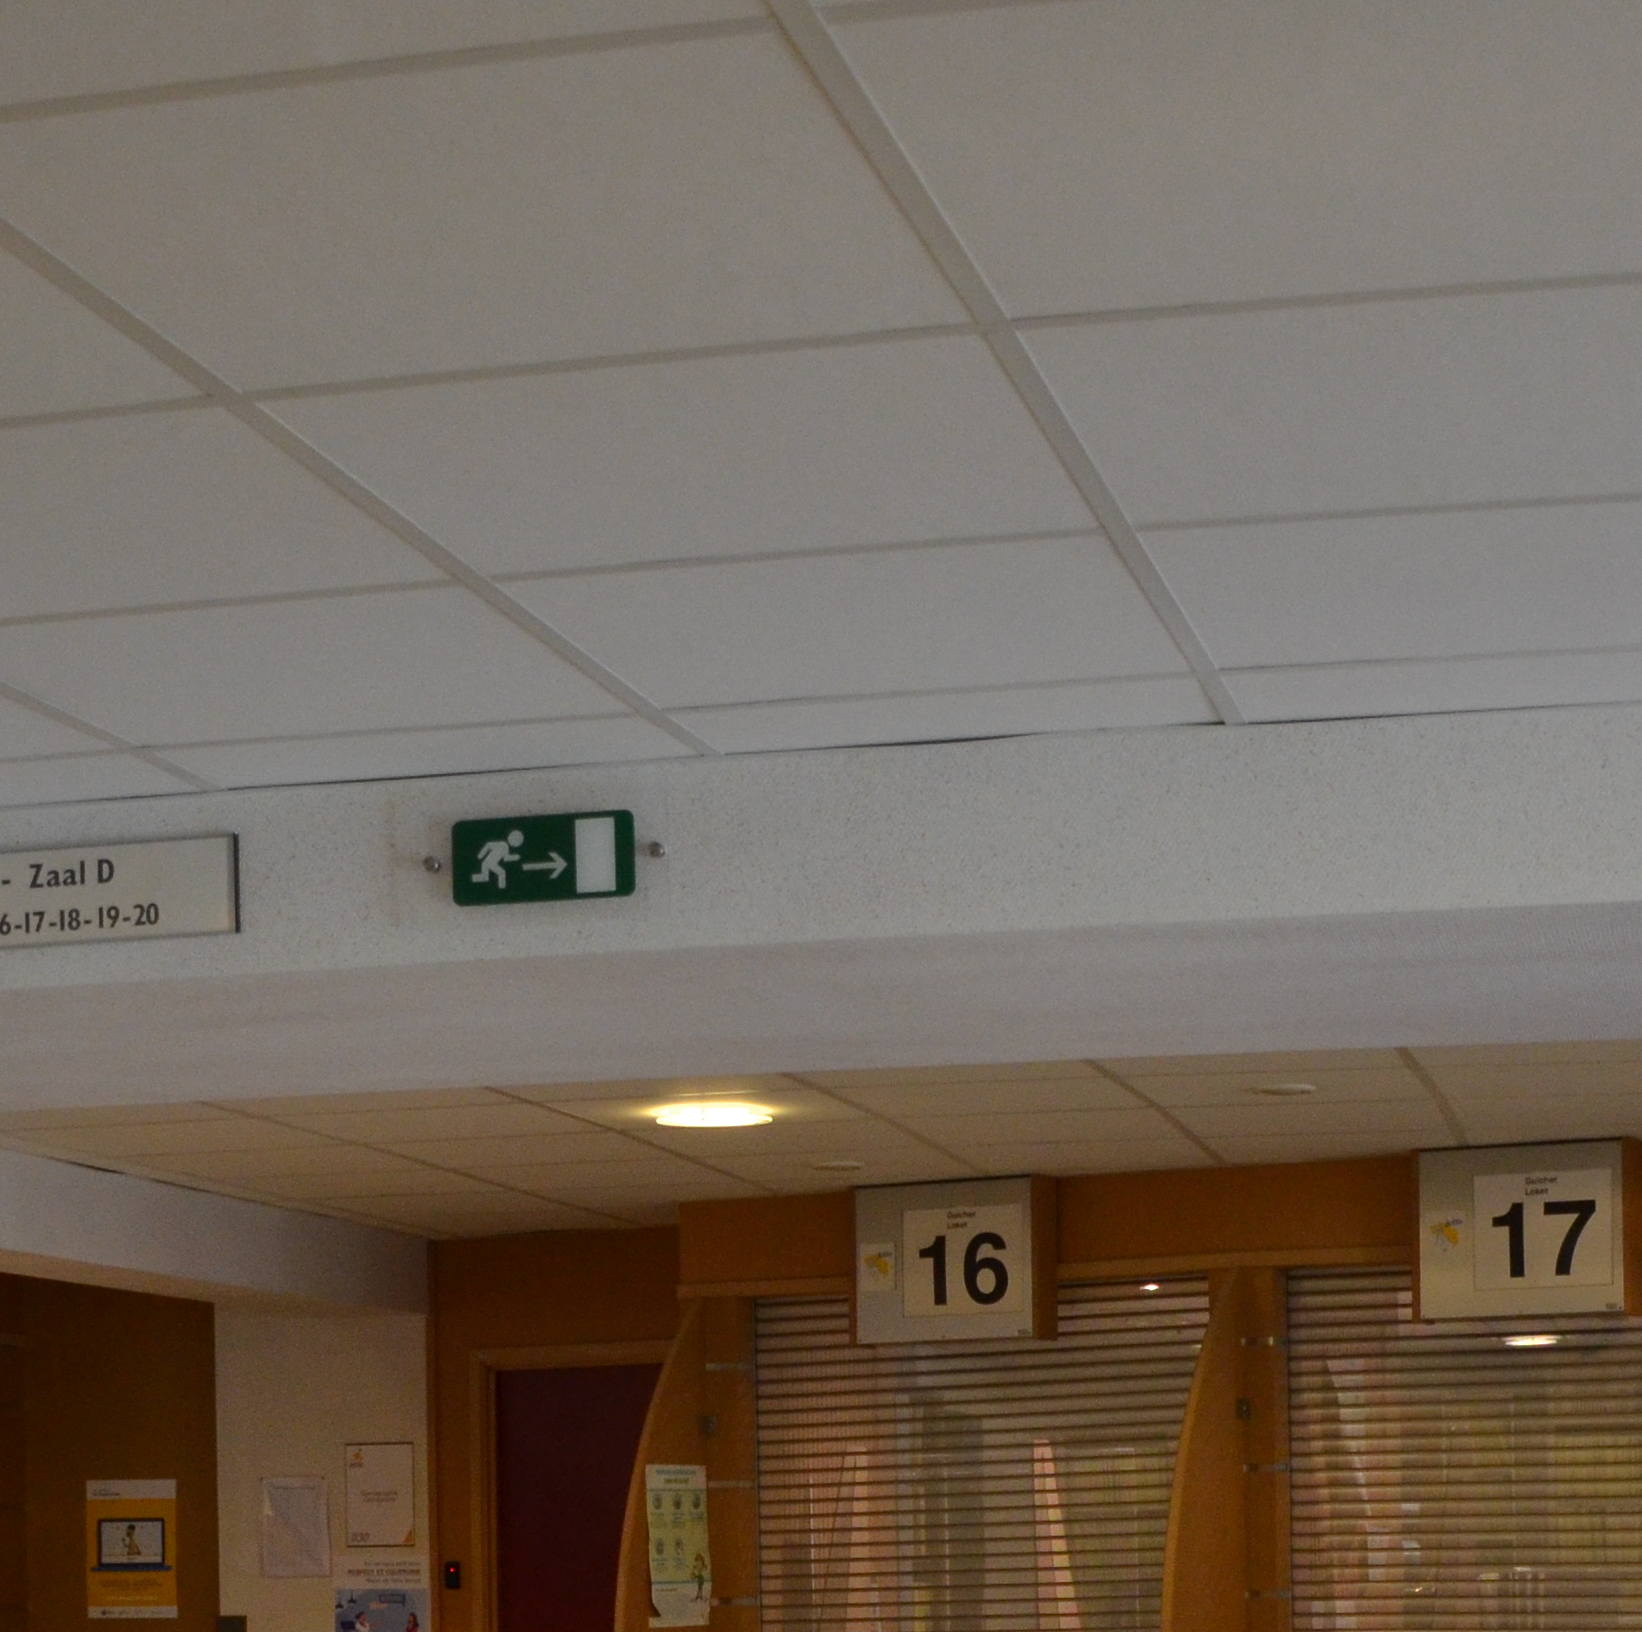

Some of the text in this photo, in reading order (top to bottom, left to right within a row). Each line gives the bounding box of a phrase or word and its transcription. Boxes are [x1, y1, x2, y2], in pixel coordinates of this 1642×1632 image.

[28, 861, 86, 890] Zaal
[97, 858, 115, 884] D
[918, 1231, 1010, 1307] 16
[1491, 1199, 1598, 1280] 17
